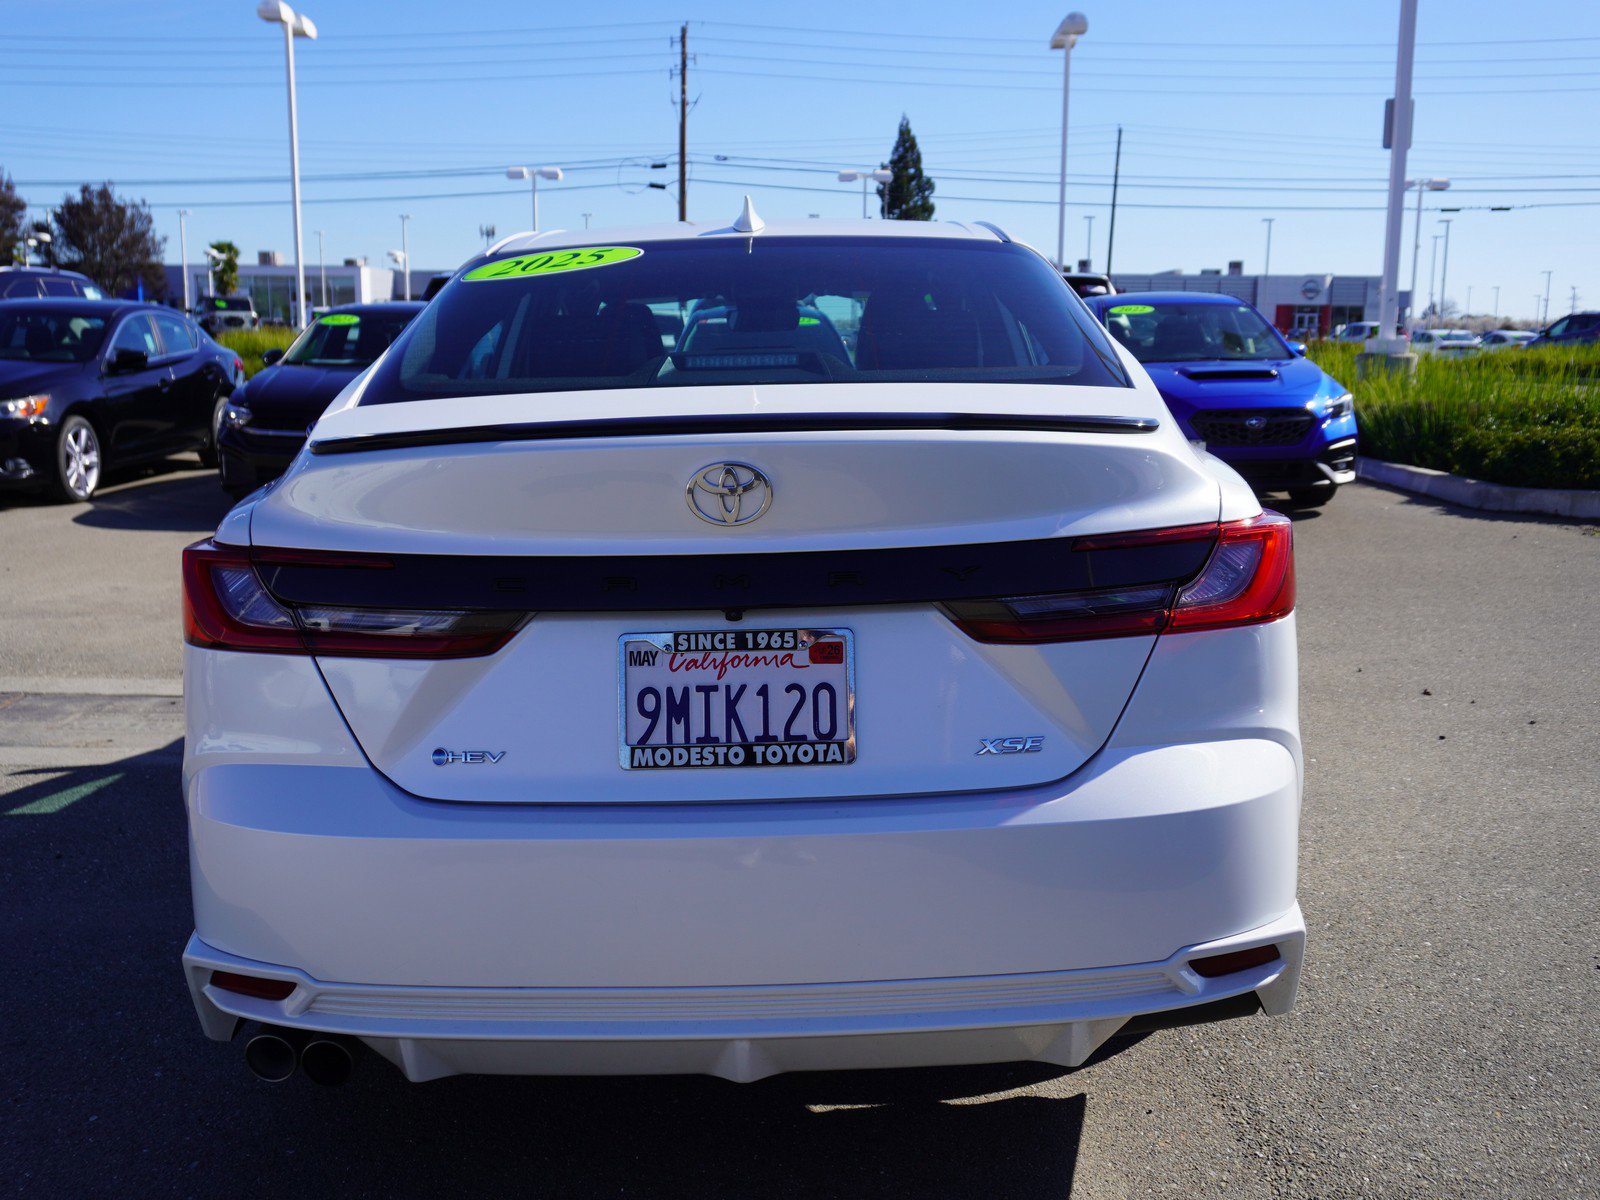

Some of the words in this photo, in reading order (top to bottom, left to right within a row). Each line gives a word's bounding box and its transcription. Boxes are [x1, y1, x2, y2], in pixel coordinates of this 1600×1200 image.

[487, 249, 615, 278] 2025
[677, 634, 736, 650] SINCE
[745, 631, 795, 649] 1965
[629, 651, 658, 667] MAY
[668, 651, 810, 680] California
[636, 682, 838, 745] 9MIK120
[632, 747, 746, 767] MODESTO
[752, 744, 844, 764] TOYOTA
[975, 735, 1045, 755] XSE
[448, 751, 507, 763] HEV
